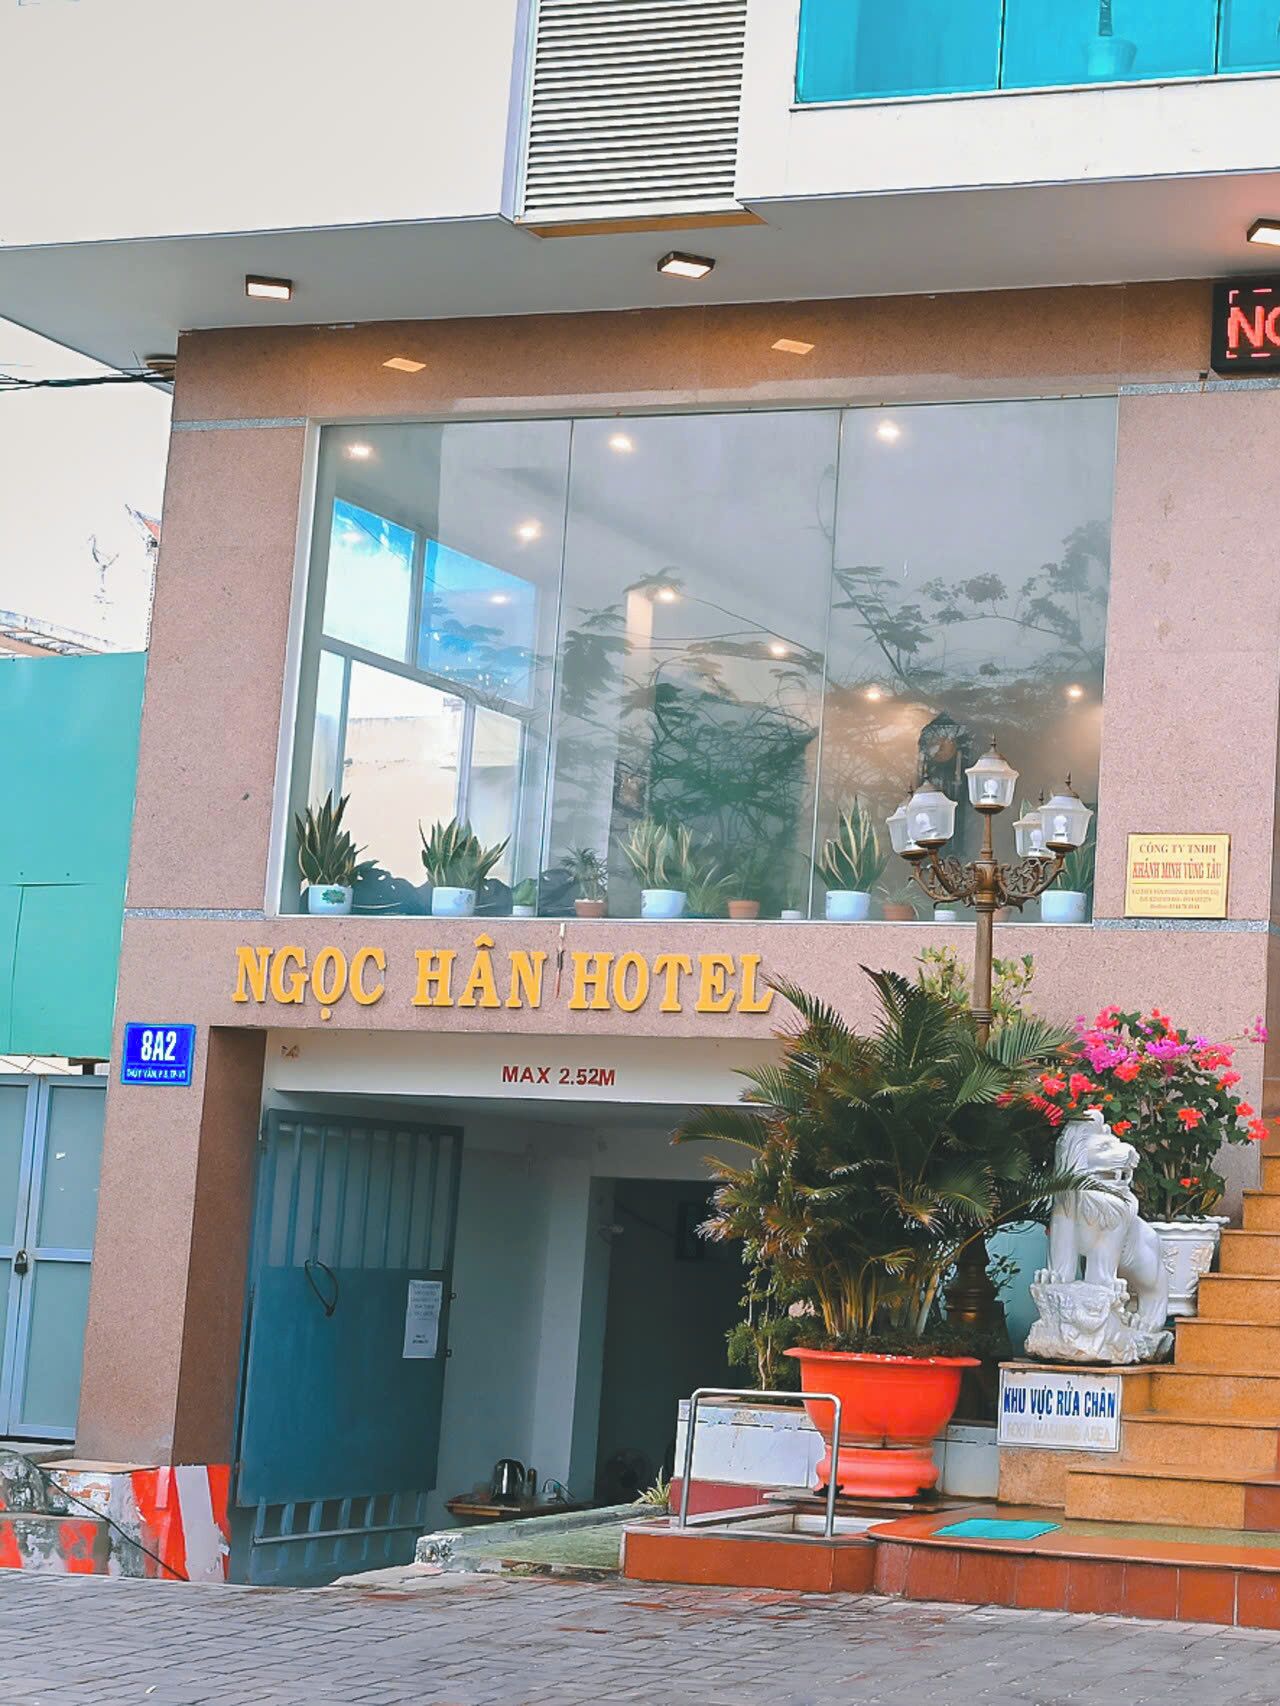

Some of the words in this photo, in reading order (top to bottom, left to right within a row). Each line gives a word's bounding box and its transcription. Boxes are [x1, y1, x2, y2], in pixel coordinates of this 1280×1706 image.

[1139, 842, 1168, 854] CÔNG
[1172, 844, 1185, 854] TY
[1187, 844, 1217, 854] TNHH
[1132, 858, 1160, 879] KHÁNH
[1161, 861, 1182, 879] MINH
[232, 945, 387, 1021] NGỌC
[411, 933, 547, 1009] HÂN
[568, 952, 775, 1014] HOTEL
[140, 1030, 177, 1061] 8A2
[502, 1065, 551, 1084] MAX
[558, 1067, 616, 1086] 2.52M
[1003, 1386, 1027, 1413] KHU
[1030, 1385, 1054, 1420] VỰC
[1056, 1380, 1080, 1416] RỬA
[1084, 1386, 1117, 1418] CHÂN
